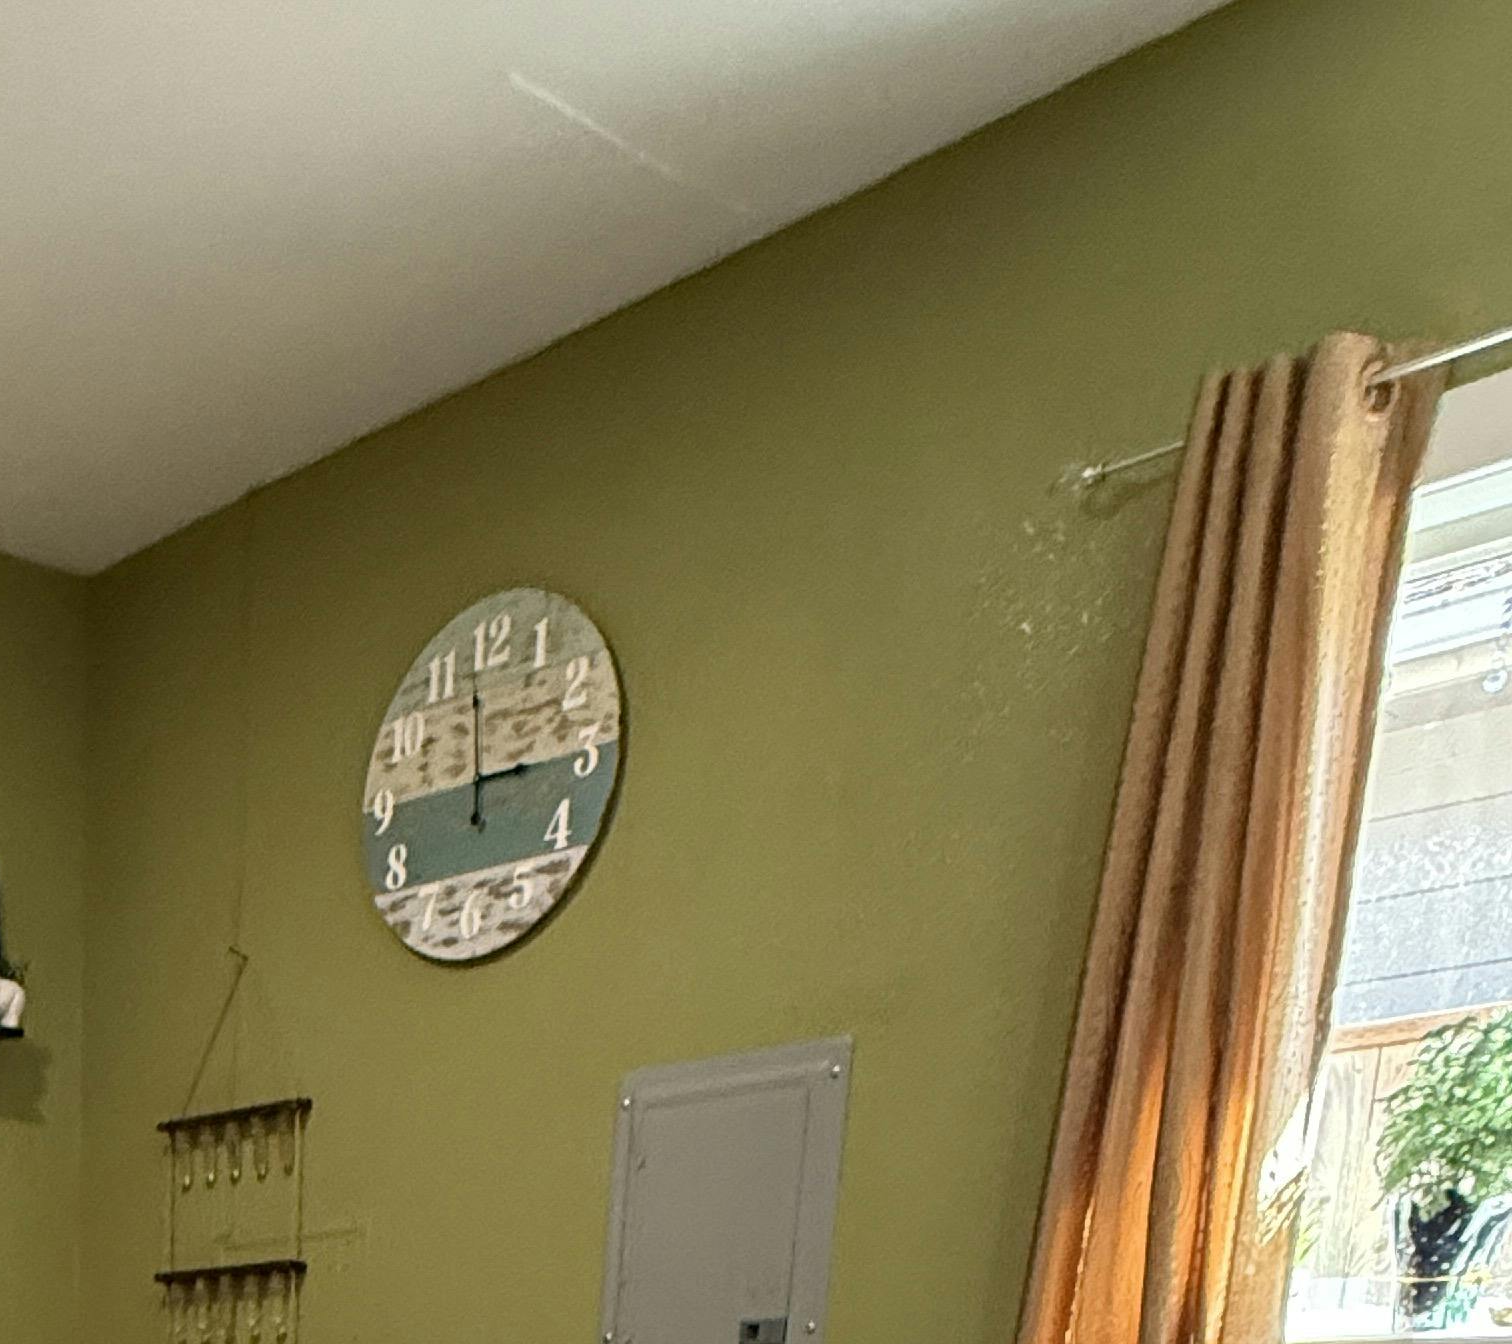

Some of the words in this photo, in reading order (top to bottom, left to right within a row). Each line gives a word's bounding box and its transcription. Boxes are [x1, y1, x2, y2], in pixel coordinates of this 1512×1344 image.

[474, 614, 512, 671] 12
[534, 617, 549, 668] 1
[428, 648, 456, 702] 11
[562, 656, 588, 711] 2
[391, 710, 426, 763] 10
[574, 726, 599, 778] 3
[374, 789, 394, 835] 9
[544, 798, 571, 850] 4
[386, 844, 407, 890] 8
[510, 865, 535, 910] 5
[418, 885, 440, 932] 7
[460, 890, 482, 939] 6
